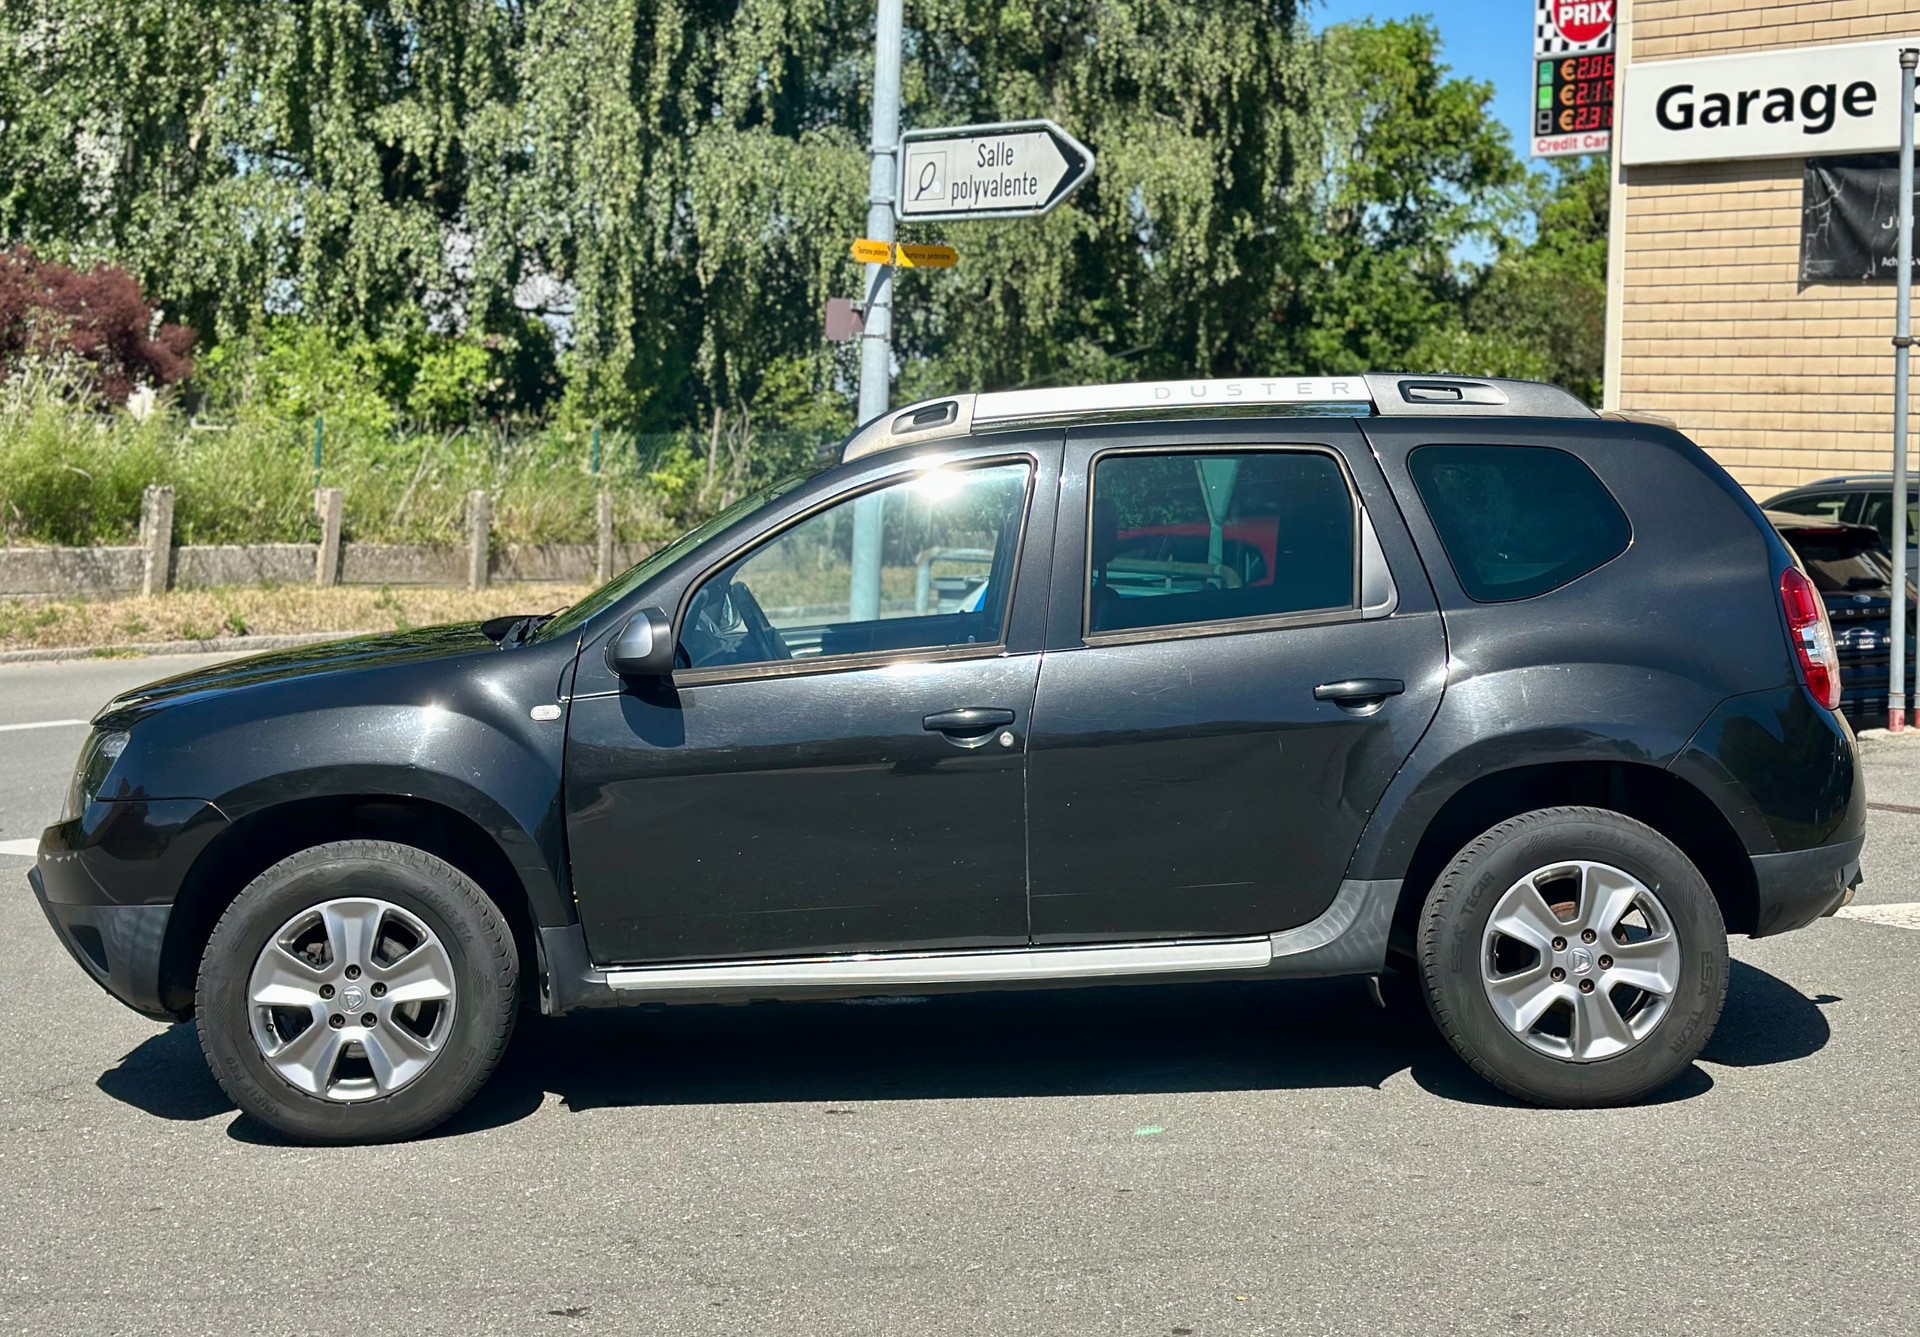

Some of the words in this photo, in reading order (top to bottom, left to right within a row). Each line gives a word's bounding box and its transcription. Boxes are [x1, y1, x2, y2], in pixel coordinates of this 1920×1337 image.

[1559, 0, 1612, 28] PRIX
[1655, 80, 1877, 135] Garage
[977, 141, 1014, 168] Salle
[1537, 135, 1577, 152] Credit
[1583, 134, 1611, 149] Car
[951, 171, 1038, 206] polyvalente
[1154, 382, 1350, 399] DUSTER
